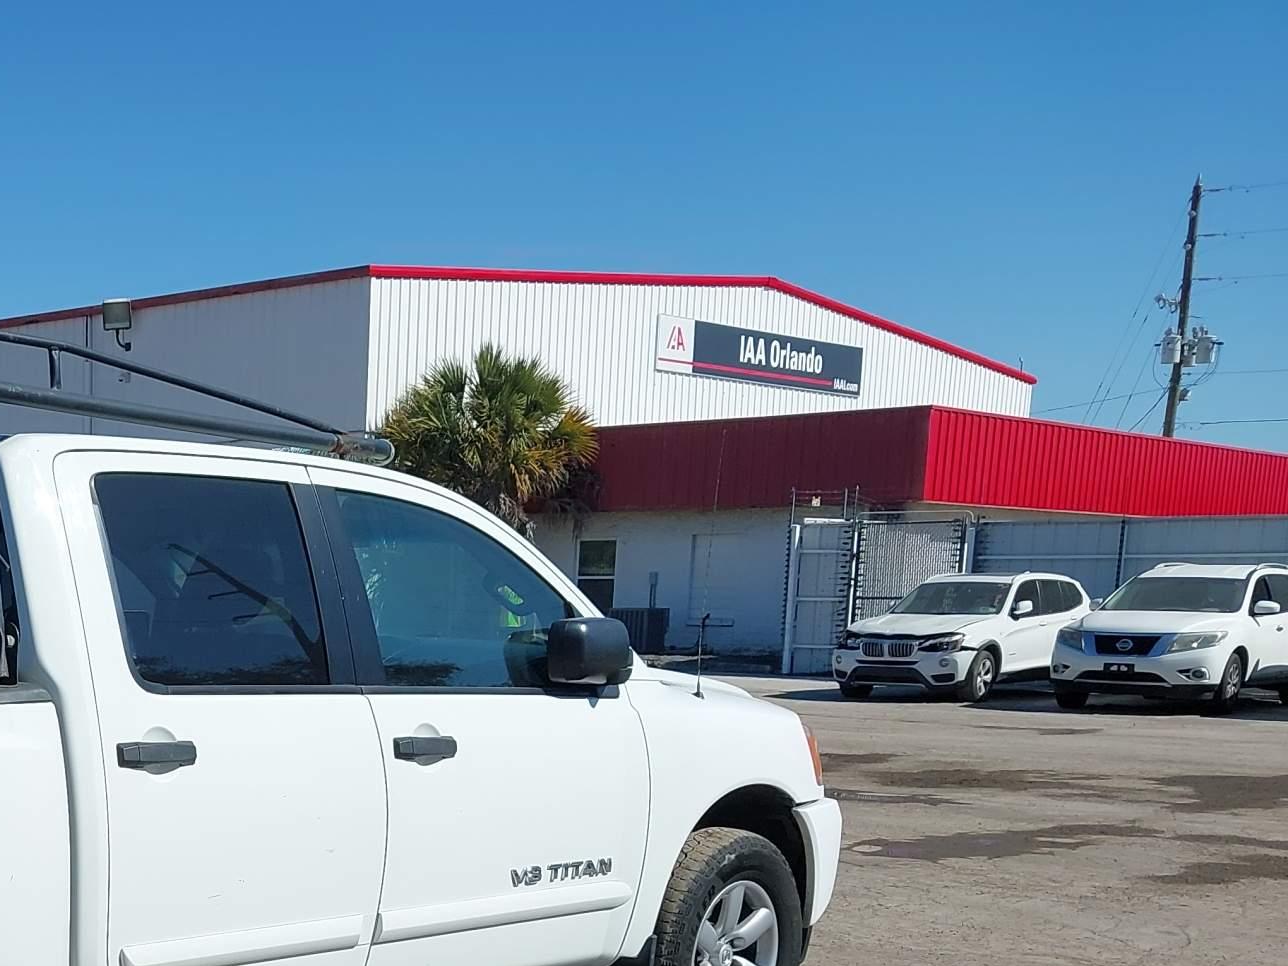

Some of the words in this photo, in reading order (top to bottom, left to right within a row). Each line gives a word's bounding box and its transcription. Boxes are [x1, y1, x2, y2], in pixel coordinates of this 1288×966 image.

[739, 334, 766, 366] IAA
[770, 339, 823, 374] Orlando
[546, 857, 612, 883] TITAN
